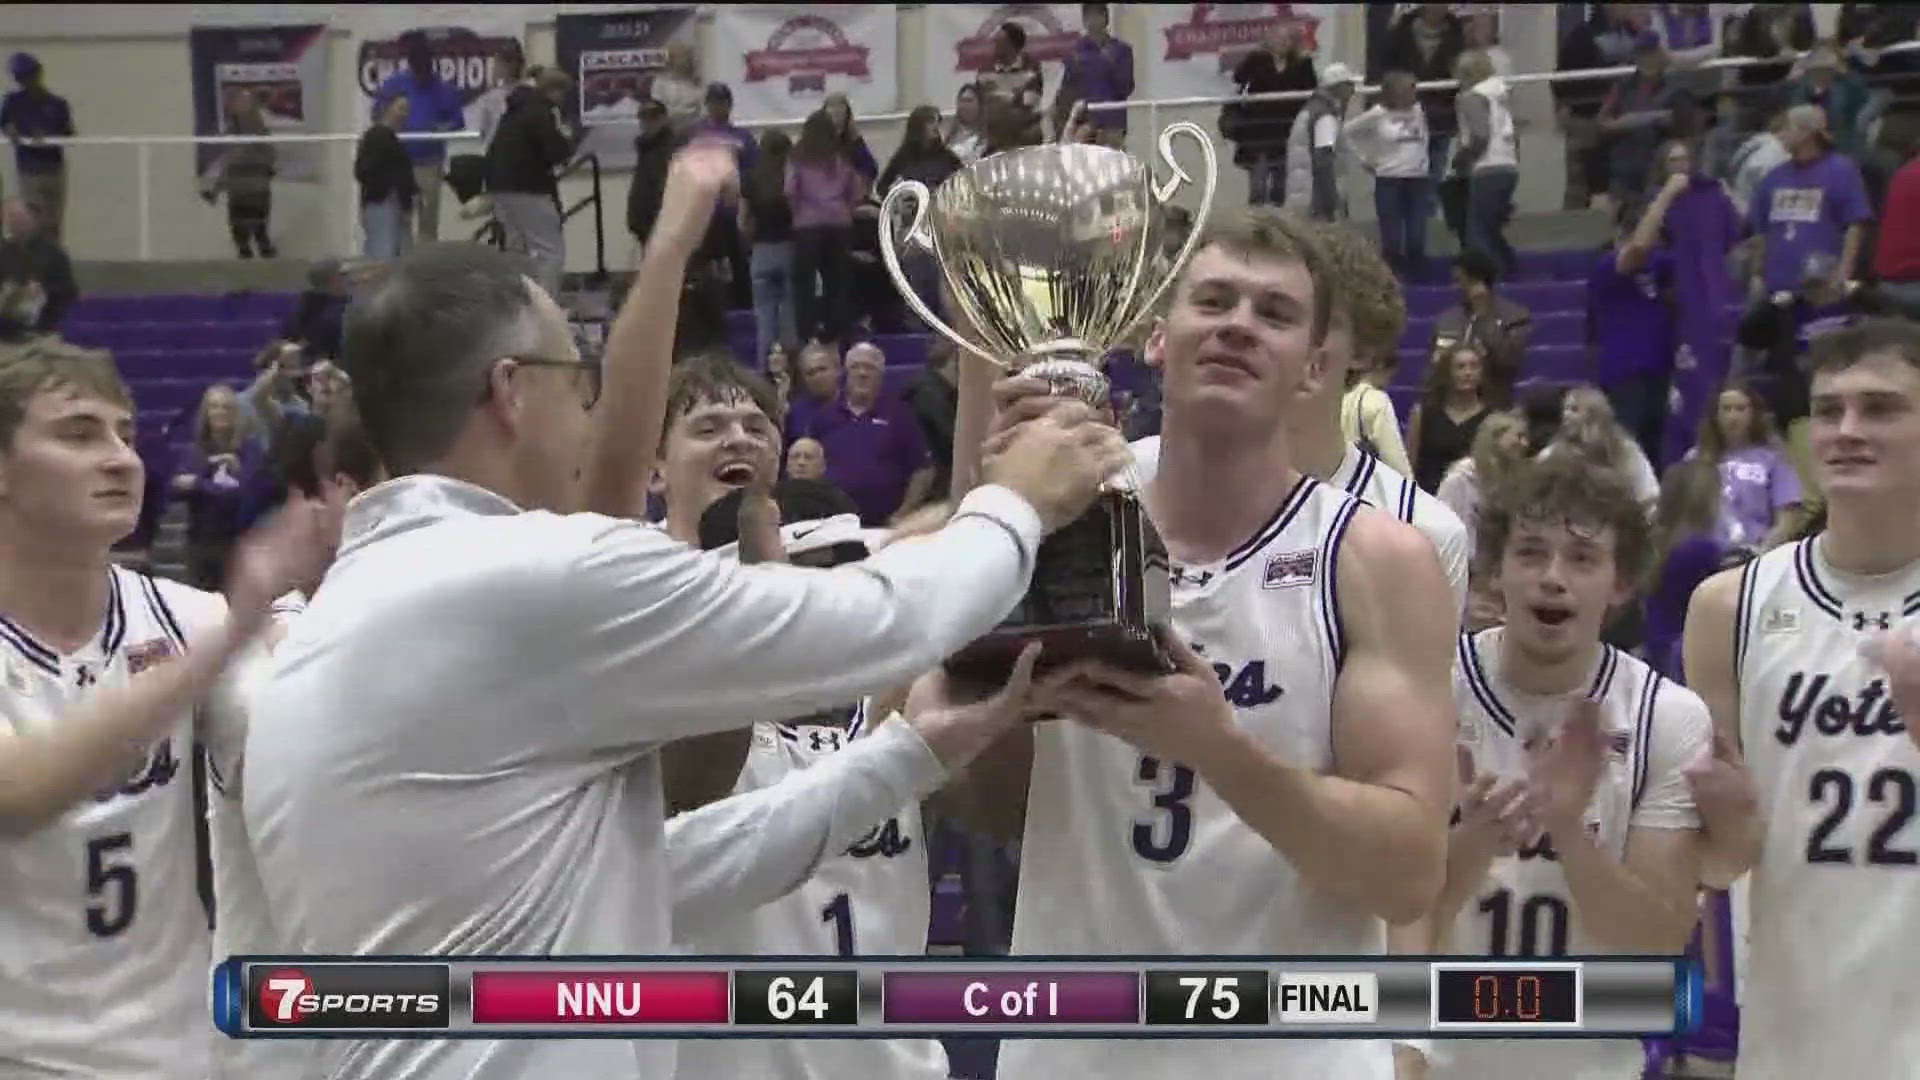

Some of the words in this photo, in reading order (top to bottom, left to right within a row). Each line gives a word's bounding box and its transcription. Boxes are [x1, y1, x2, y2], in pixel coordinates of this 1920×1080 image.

[1775, 672, 1906, 746] Yote
[1132, 756, 1195, 863] 3
[1807, 769, 1917, 865] 22
[86, 832, 137, 938] 5
[822, 893, 854, 956] 1
[1479, 888, 1568, 956] 10
